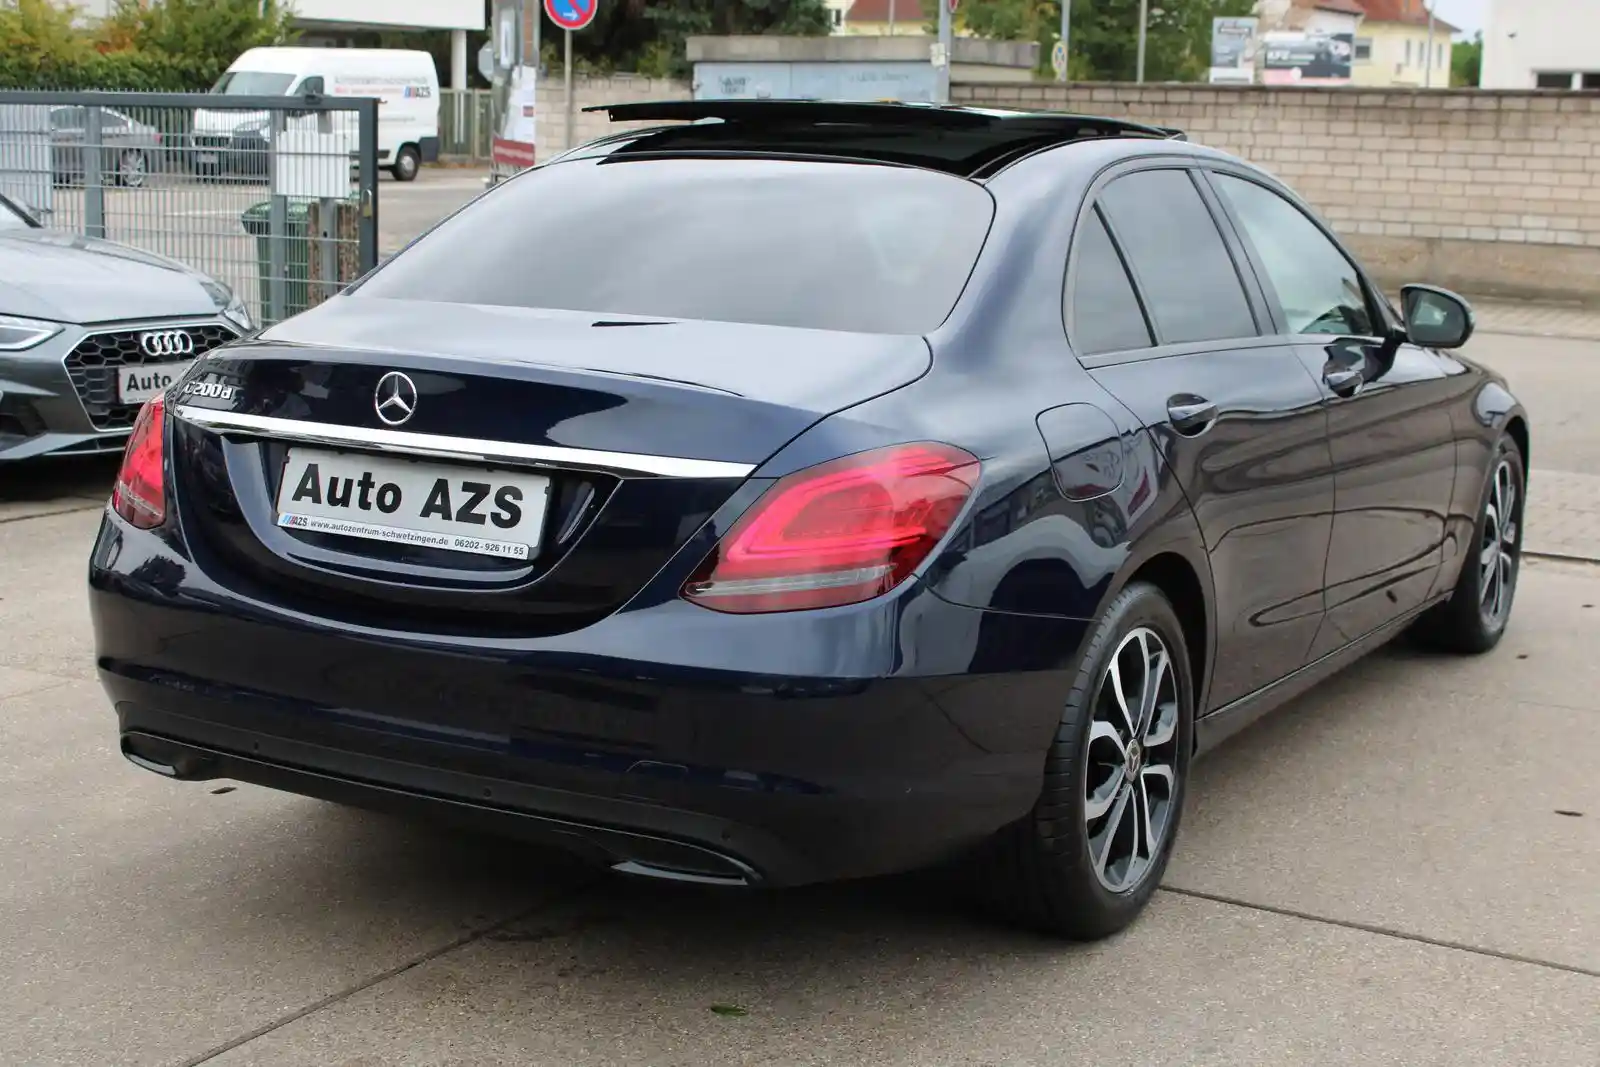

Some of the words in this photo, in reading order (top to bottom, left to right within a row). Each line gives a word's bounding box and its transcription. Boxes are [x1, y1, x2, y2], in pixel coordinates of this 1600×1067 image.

[127, 372, 171, 392] Auto
[291, 463, 402, 514] Auto
[419, 478, 524, 529] AZS
[310, 520, 449, 546] www.autozentrum-schwetzingen.de
